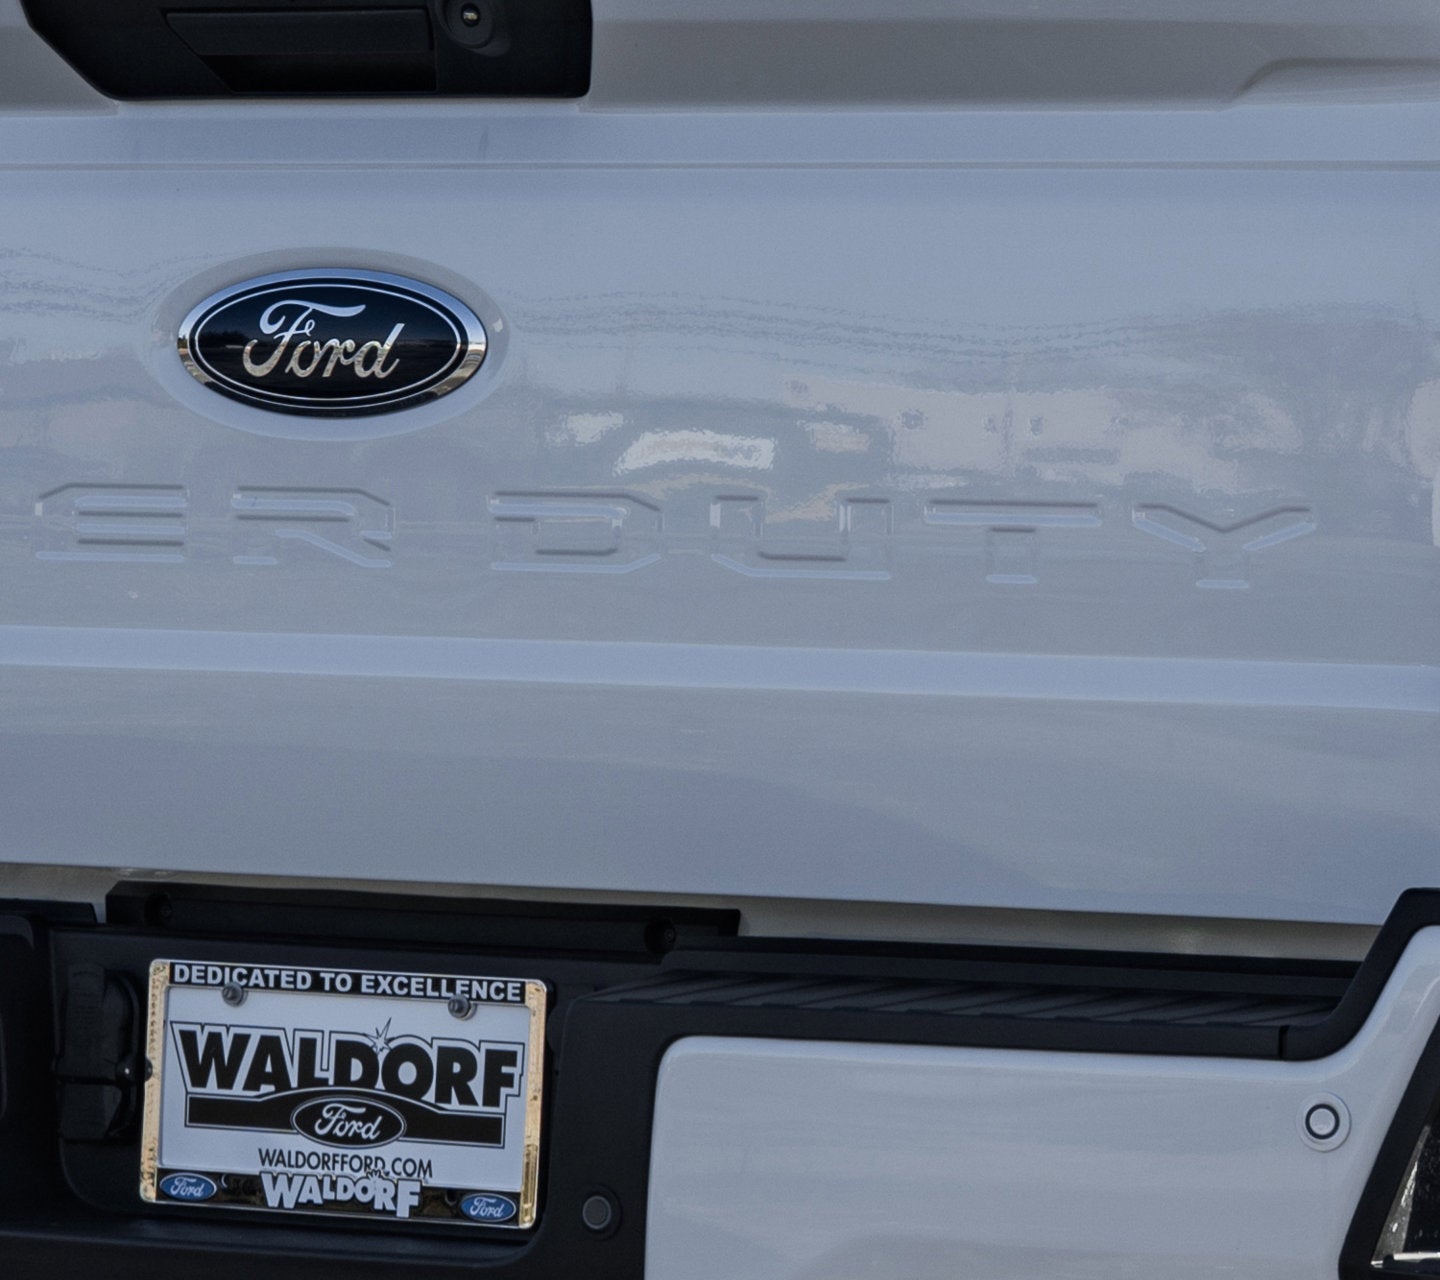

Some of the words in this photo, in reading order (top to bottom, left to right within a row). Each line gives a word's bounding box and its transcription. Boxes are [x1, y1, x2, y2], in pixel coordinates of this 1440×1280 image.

[242, 299, 406, 379] Ford
[488, 489, 1316, 588] DUTY
[173, 964, 312, 991] DEDICATED
[320, 972, 353, 993] TO
[360, 974, 522, 1003] EXCELLENCE
[176, 1026, 521, 1110] WALDORF
[314, 1102, 383, 1142] Ford
[258, 1147, 434, 1181] WALDORFFORD.COM
[168, 1176, 206, 1199] Ford
[260, 1170, 422, 1219] WALDORF
[468, 1196, 505, 1220] Ford
